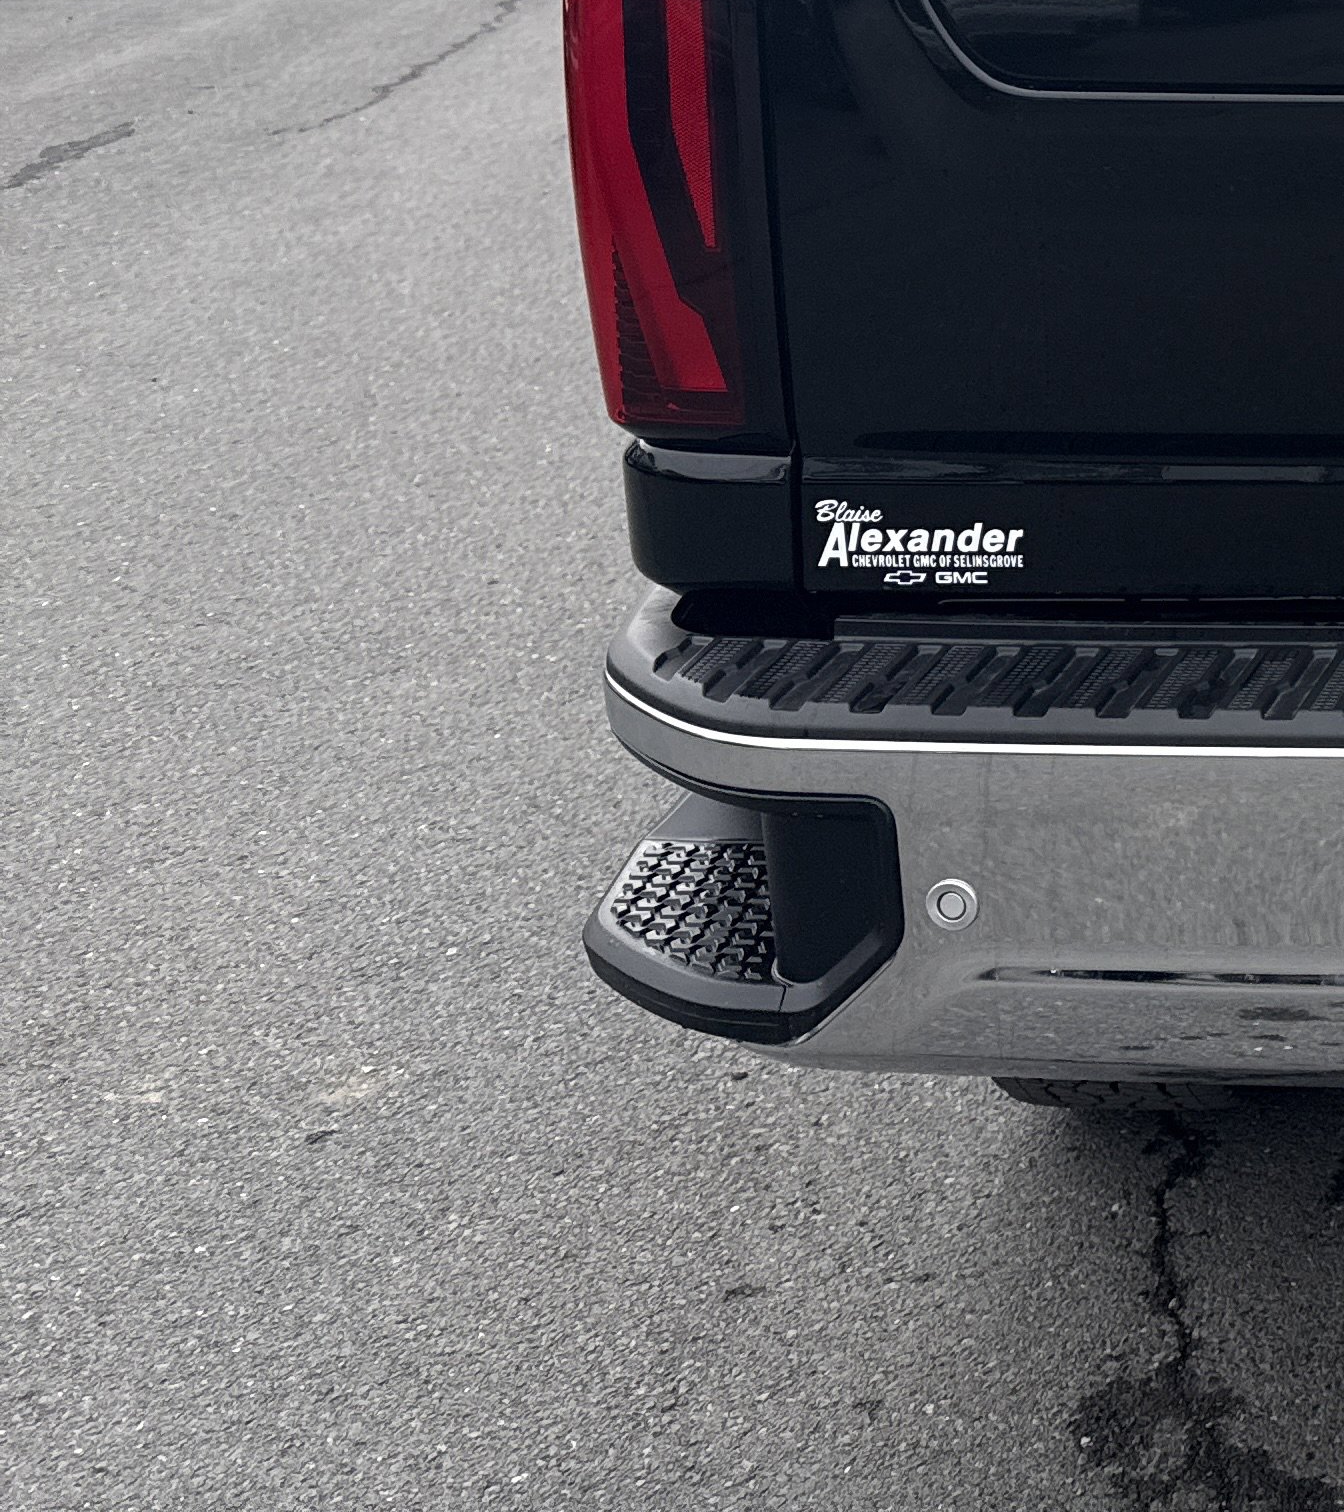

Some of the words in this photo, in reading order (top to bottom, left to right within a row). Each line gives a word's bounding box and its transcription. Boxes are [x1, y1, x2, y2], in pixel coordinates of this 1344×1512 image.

[814, 499, 883, 522] Blaise
[817, 522, 1024, 567] Alexander
[852, 554, 911, 568] CHEVROLET
[913, 555, 937, 568] GMC
[939, 555, 952, 568] OF
[953, 554, 1024, 568] SELINSGROVE
[935, 571, 988, 584] GMC
